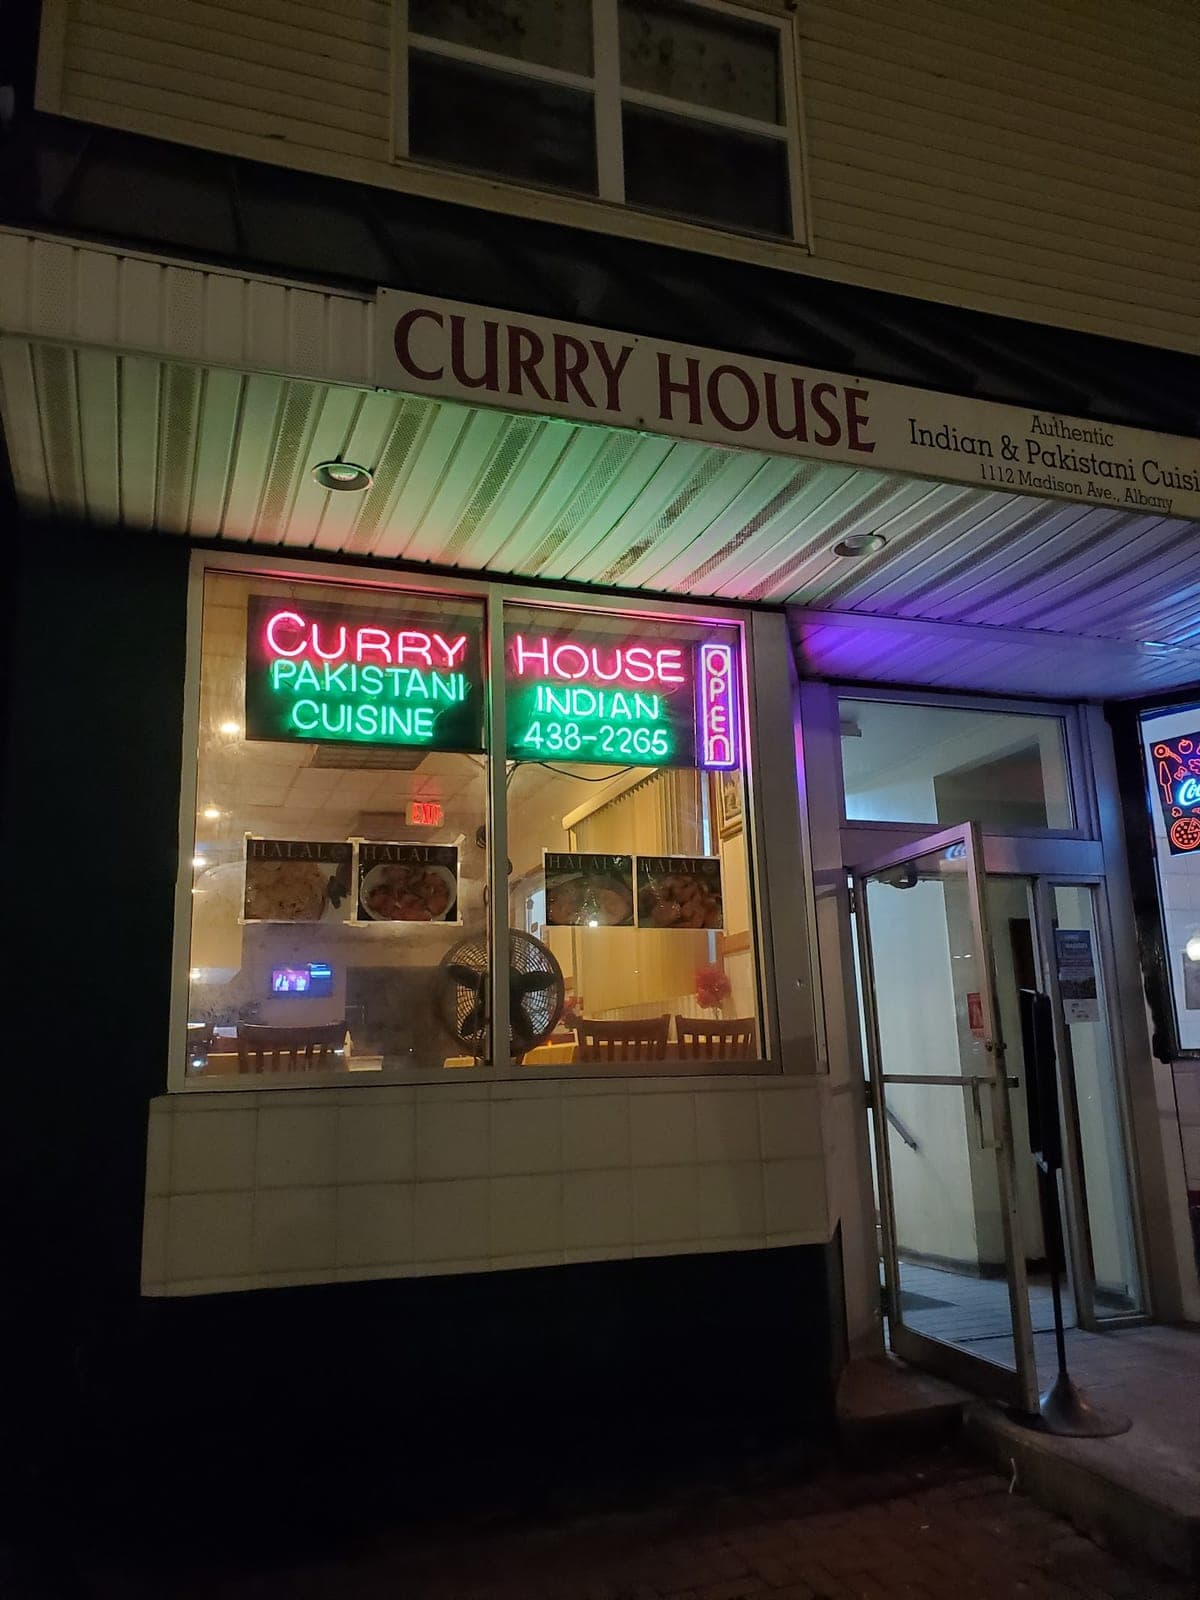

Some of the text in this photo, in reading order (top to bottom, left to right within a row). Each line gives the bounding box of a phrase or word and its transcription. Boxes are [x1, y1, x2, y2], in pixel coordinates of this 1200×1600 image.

[394, 308, 877, 453] CURRY HOUSE
[908, 418, 993, 457] Indian
[1001, 435, 1019, 462] &
[1025, 439, 1137, 482] Pakistani
[1031, 415, 1114, 447] Authentic
[980, 464, 1173, 515] 1112 Madison Ave., Albany
[267, 611, 467, 667] CURRY
[517, 635, 685, 682] HOUSE
[272, 659, 465, 701] PAKISTANI
[292, 699, 433, 737] CUISINE
[536, 686, 659, 720] INDIAN
[523, 721, 668, 755] 438-2265
[252, 842, 325, 859] HALAL
[364, 847, 434, 862] HALAL
